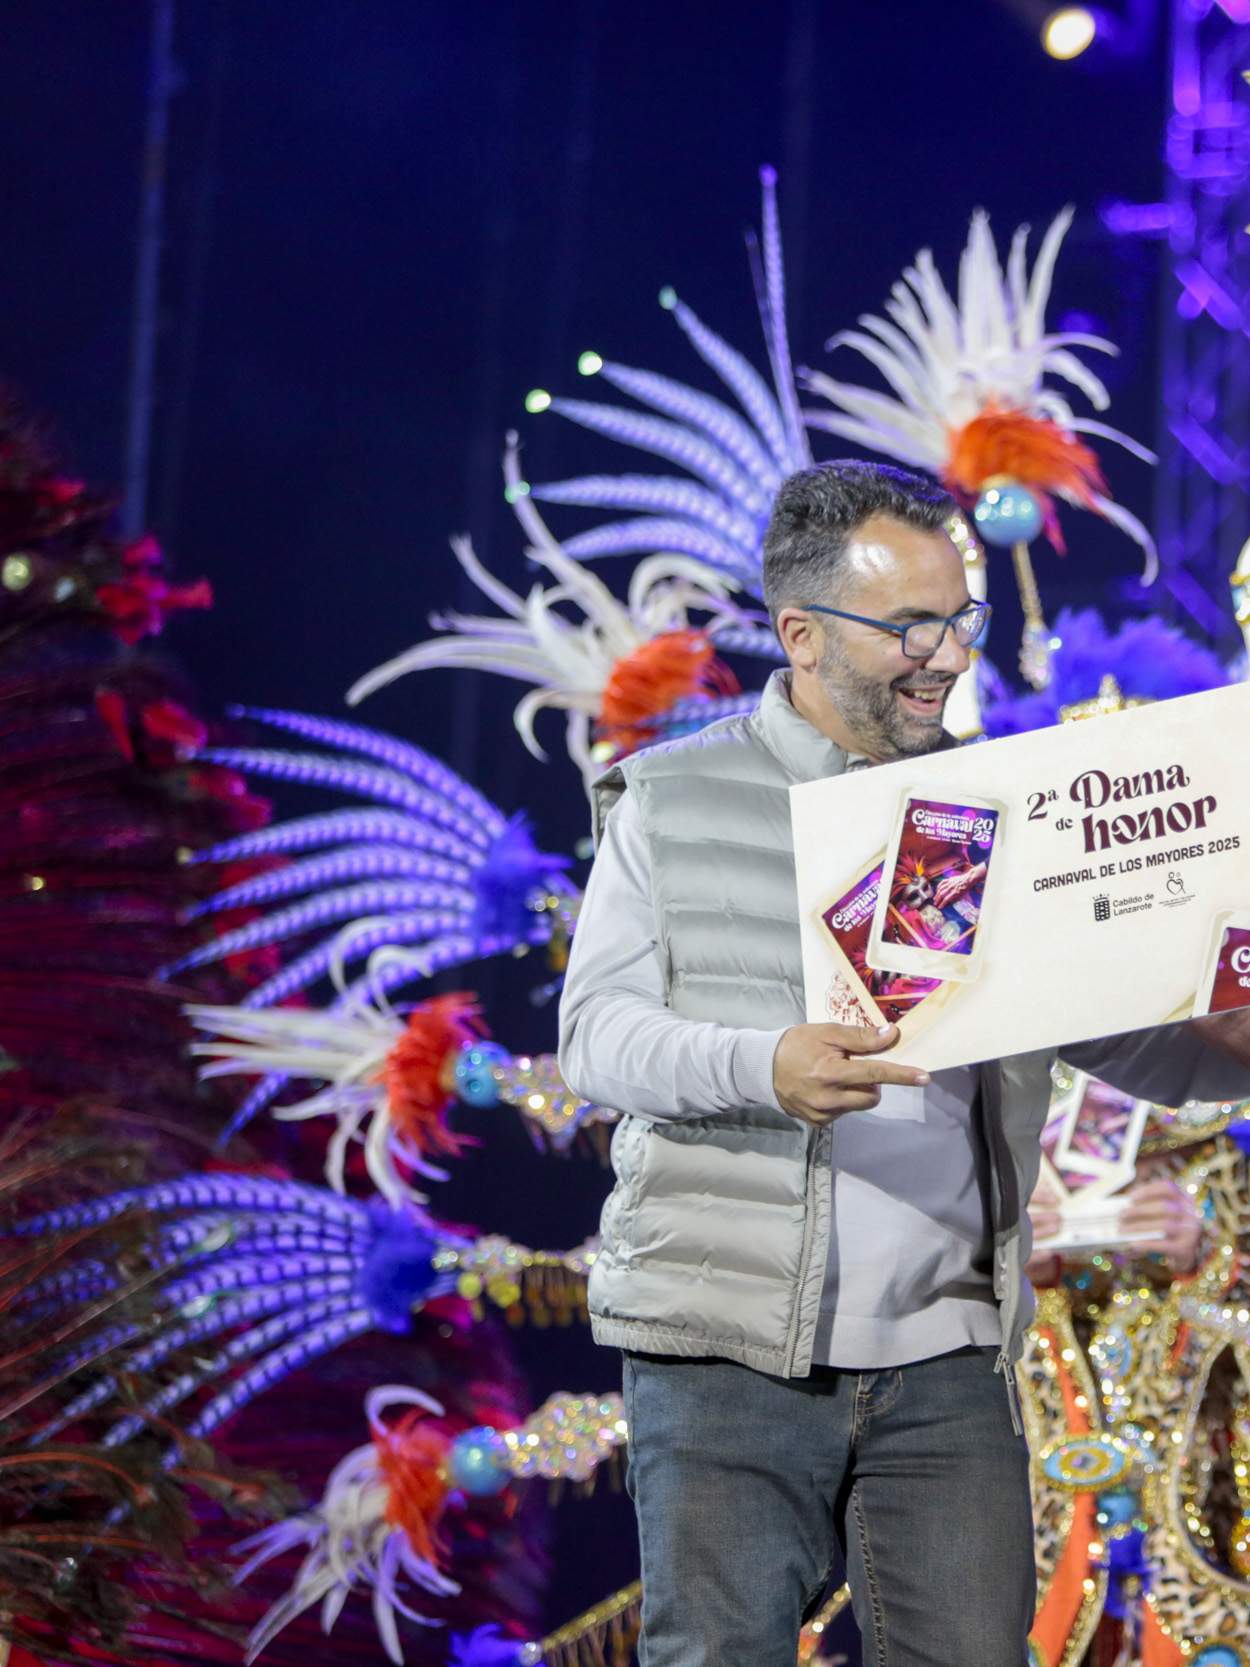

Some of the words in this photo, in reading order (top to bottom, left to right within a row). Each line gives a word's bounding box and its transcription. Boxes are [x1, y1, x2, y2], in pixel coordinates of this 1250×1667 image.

[1069, 764, 1190, 809] Dama
[912, 809, 974, 832] Carnaval
[974, 817, 994, 830] 20
[1055, 817, 1073, 831] de
[1082, 795, 1217, 853] honor
[972, 828, 992, 843] 25
[1033, 867, 1096, 892] CARNAVAL
[1100, 864, 1115, 877] DE
[1119, 857, 1142, 874] LOS
[1146, 844, 1204, 868] MAYORES
[1208, 836, 1240, 854] 2025
[1113, 896, 1142, 907] Cabildo
[1144, 893, 1154, 901] de
[1113, 902, 1152, 916] Lanzarote
